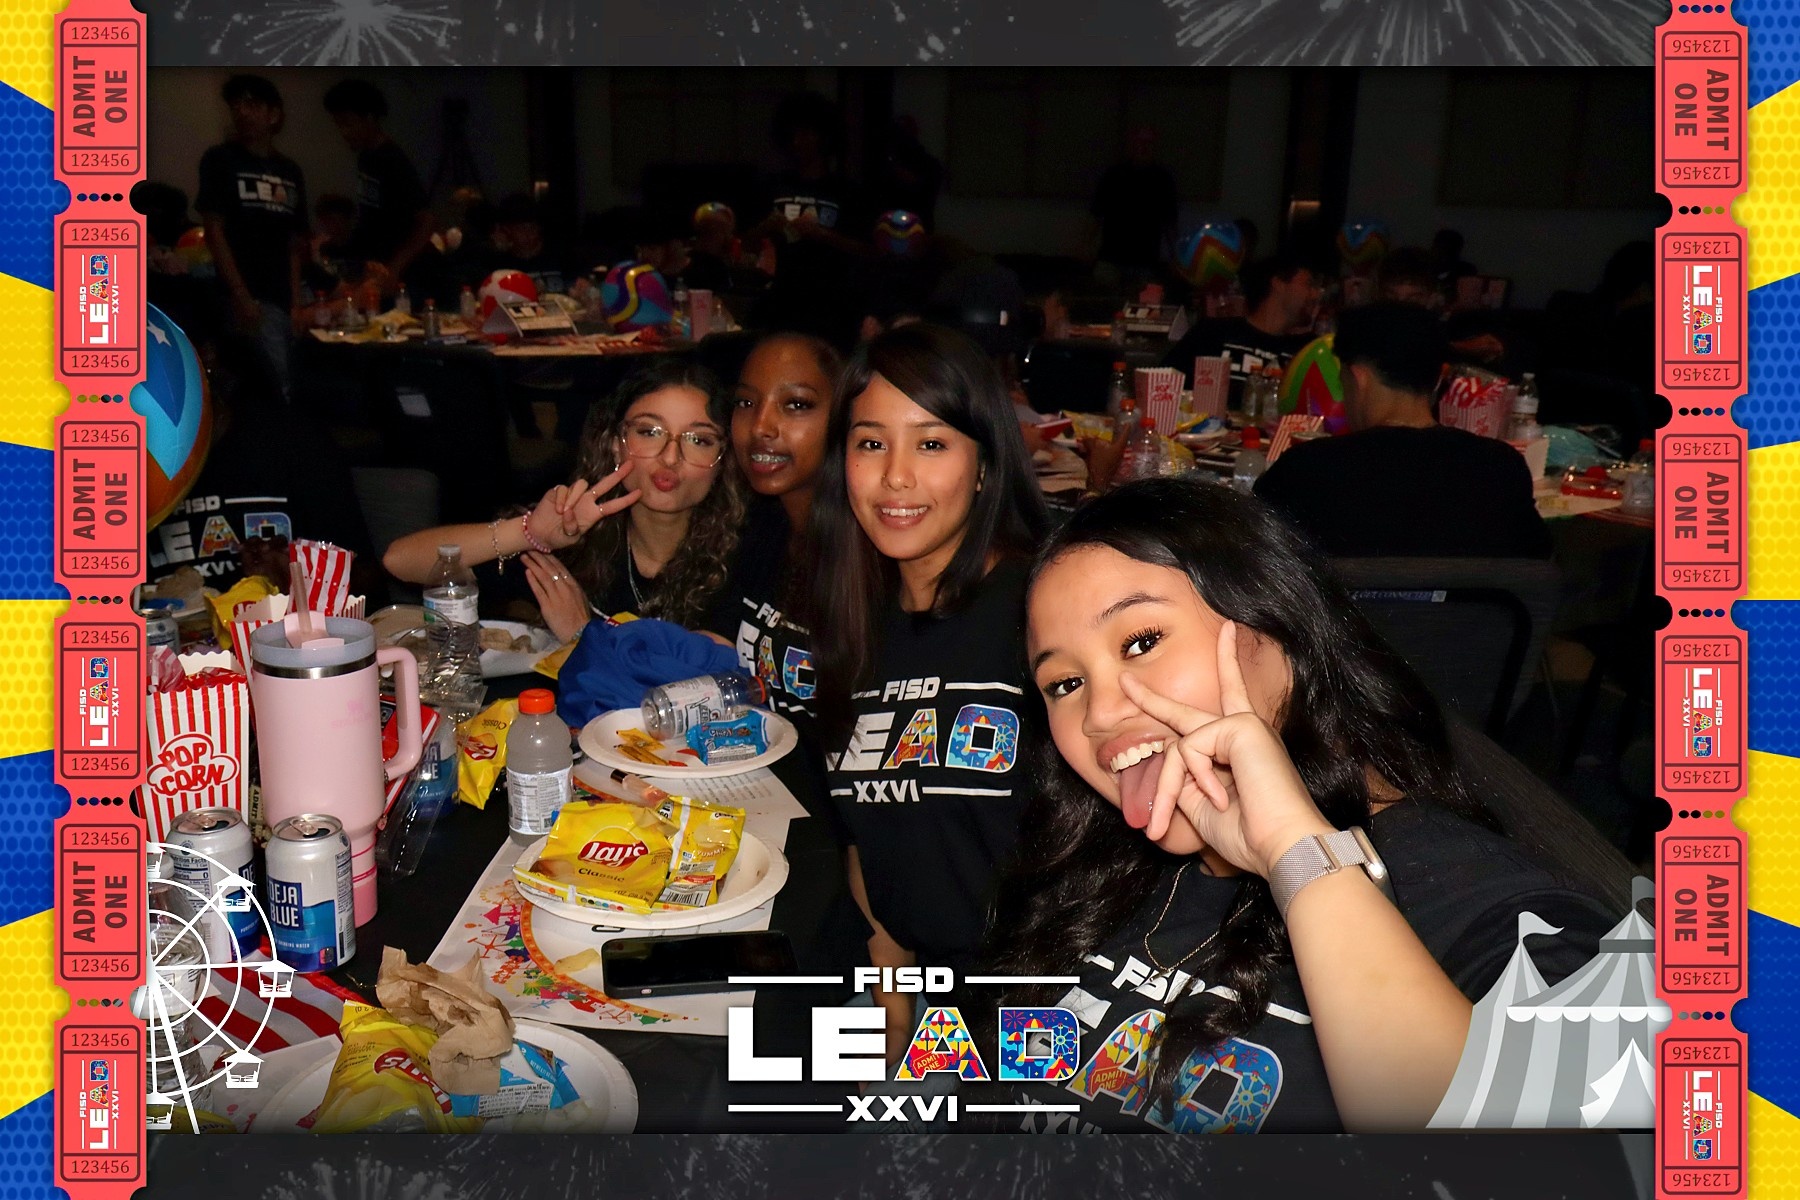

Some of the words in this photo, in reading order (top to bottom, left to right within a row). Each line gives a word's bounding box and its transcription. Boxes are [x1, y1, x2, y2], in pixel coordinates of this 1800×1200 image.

[882, 677, 941, 702] FISD
[827, 704, 1021, 773] EAD
[158, 743, 207, 772] POP
[160, 763, 225, 796] CORN
[853, 779, 920, 803] XXVI
[587, 841, 646, 867] Lay's
[268, 882, 298, 905] DEJA
[270, 904, 300, 927] BLUE
